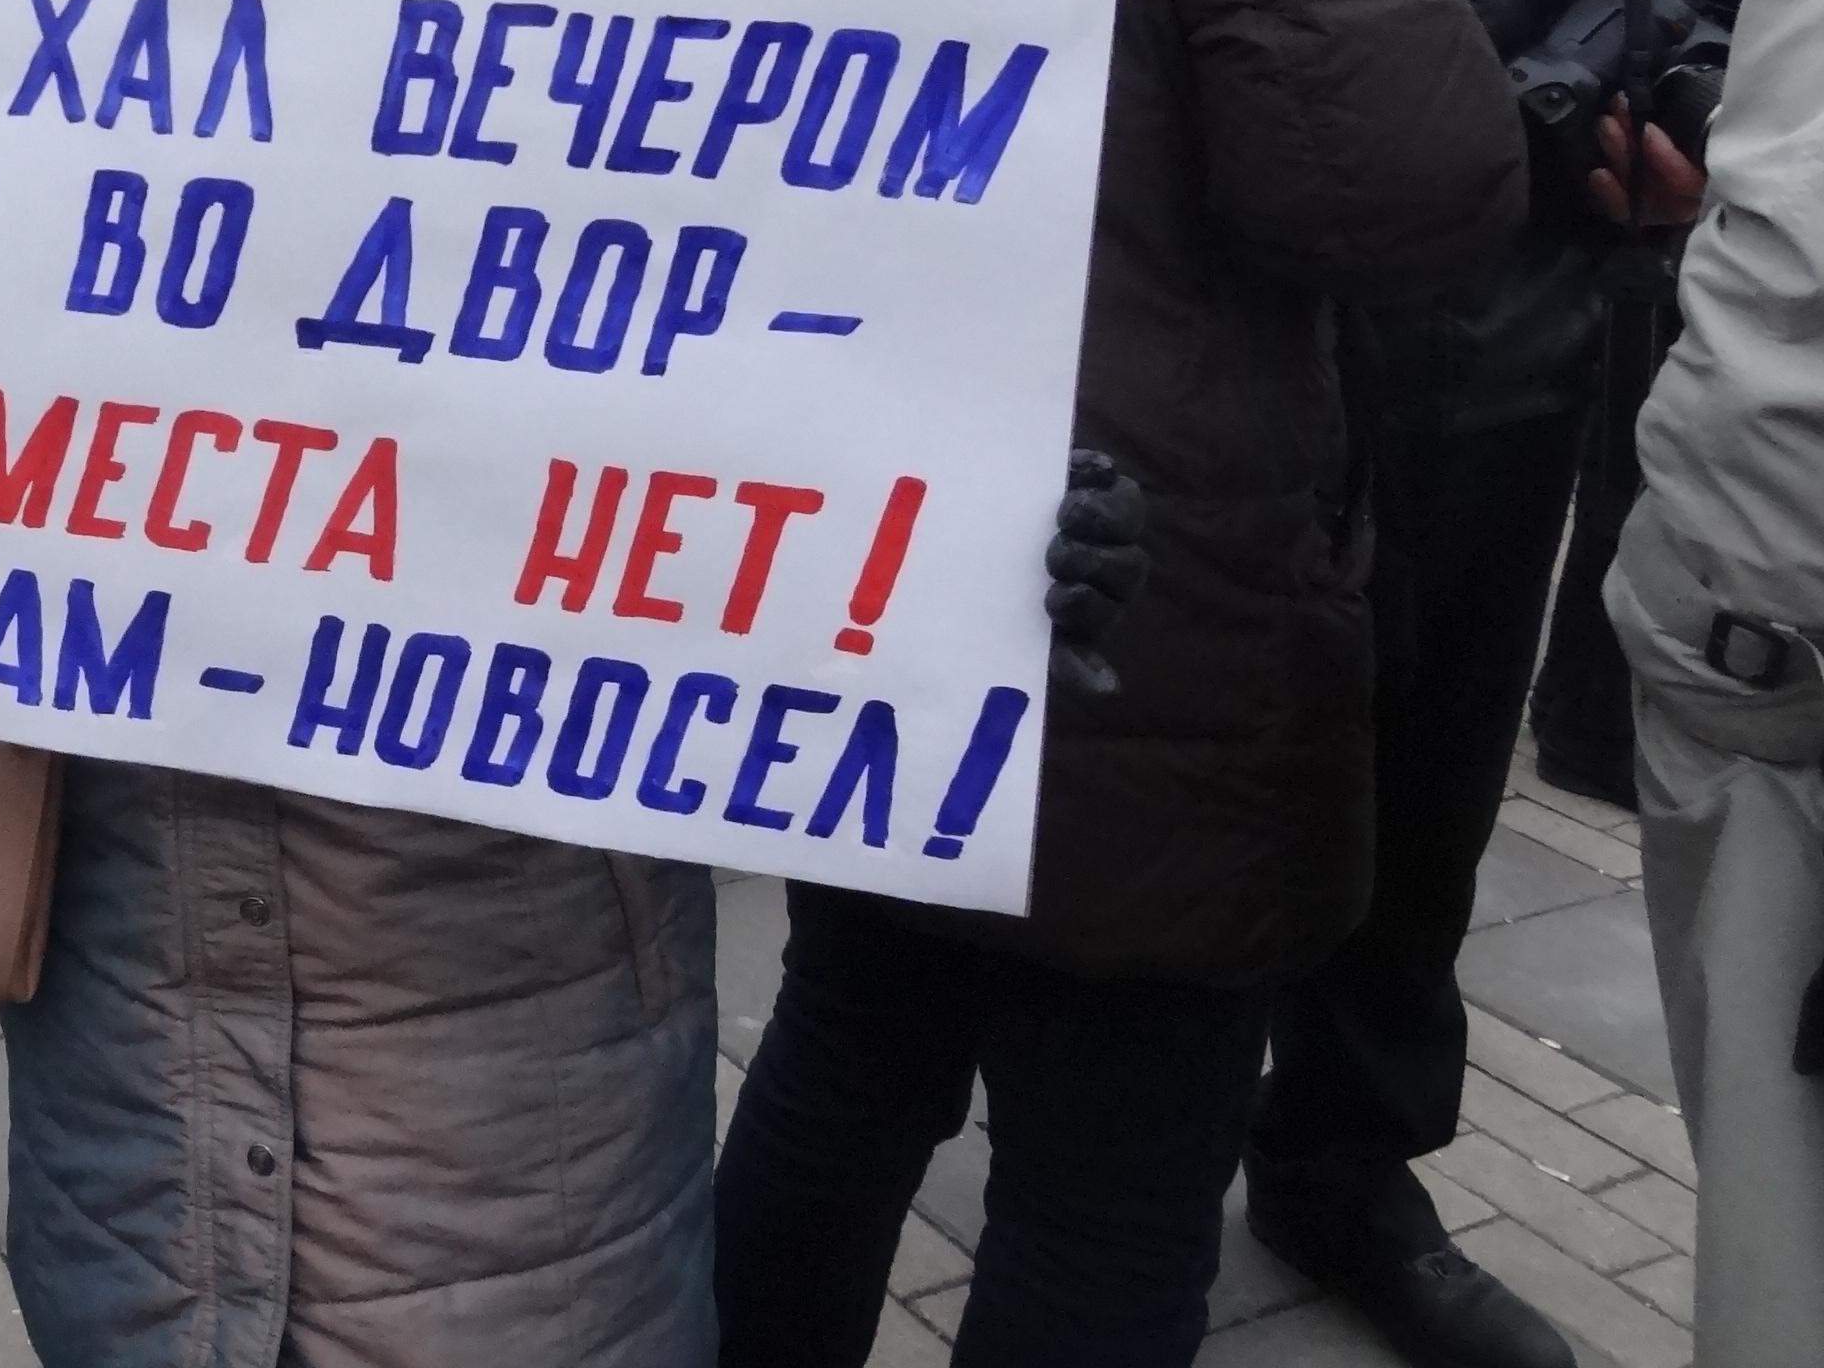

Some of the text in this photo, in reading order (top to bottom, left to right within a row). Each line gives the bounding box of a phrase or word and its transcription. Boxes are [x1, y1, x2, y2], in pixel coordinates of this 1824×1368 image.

[65, 169, 255, 329] ВО
[514, 459, 928, 657] НЕТ!
[287, 615, 1030, 861] НОВОСЕЛ!
